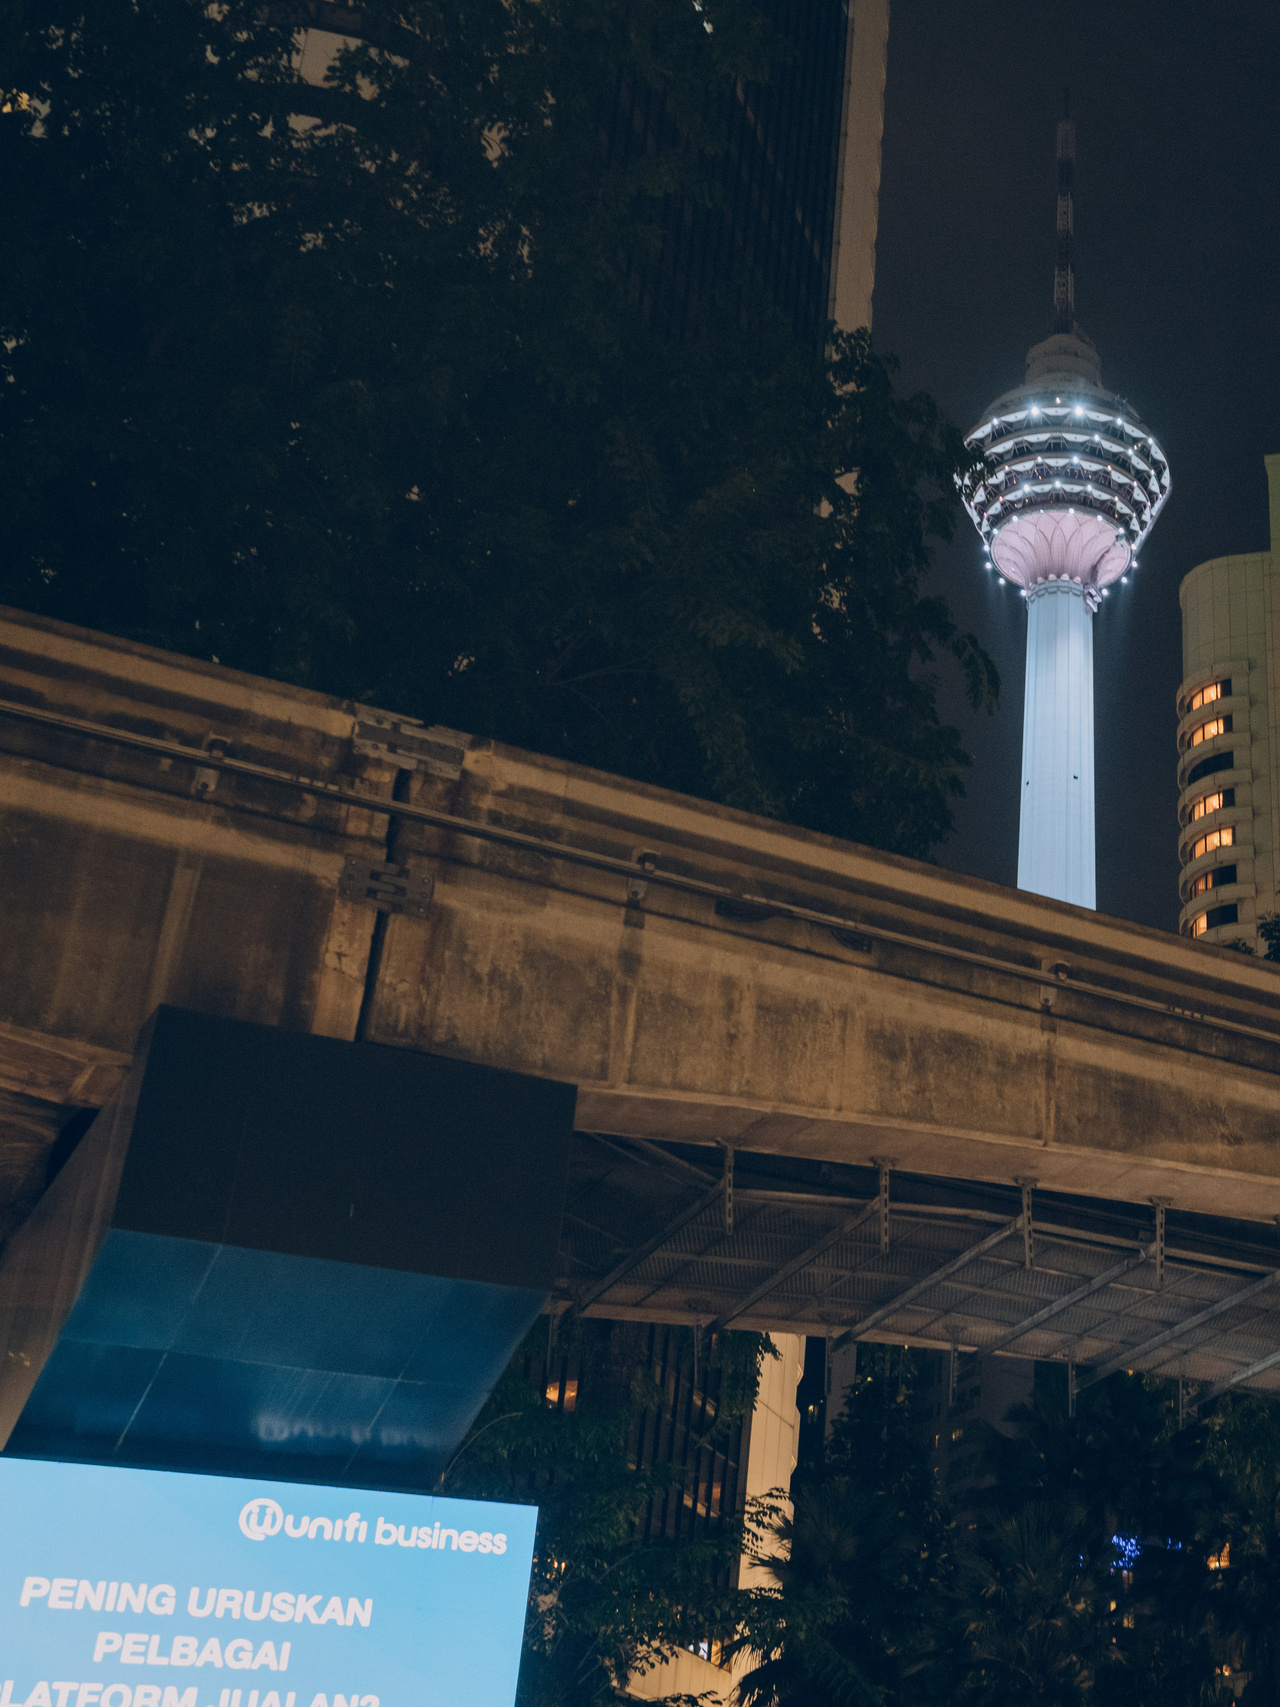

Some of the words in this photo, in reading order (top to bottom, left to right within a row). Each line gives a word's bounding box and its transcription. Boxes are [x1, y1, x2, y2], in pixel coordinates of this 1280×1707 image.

[283, 1511, 369, 1544] unifi
[374, 1516, 508, 1555] business
[19, 1576, 177, 1616] PENING
[186, 1586, 374, 1628] URUSKAN
[92, 1631, 292, 1672] PELBAGAI
[0, 1679, 199, 1707] LATFORM
